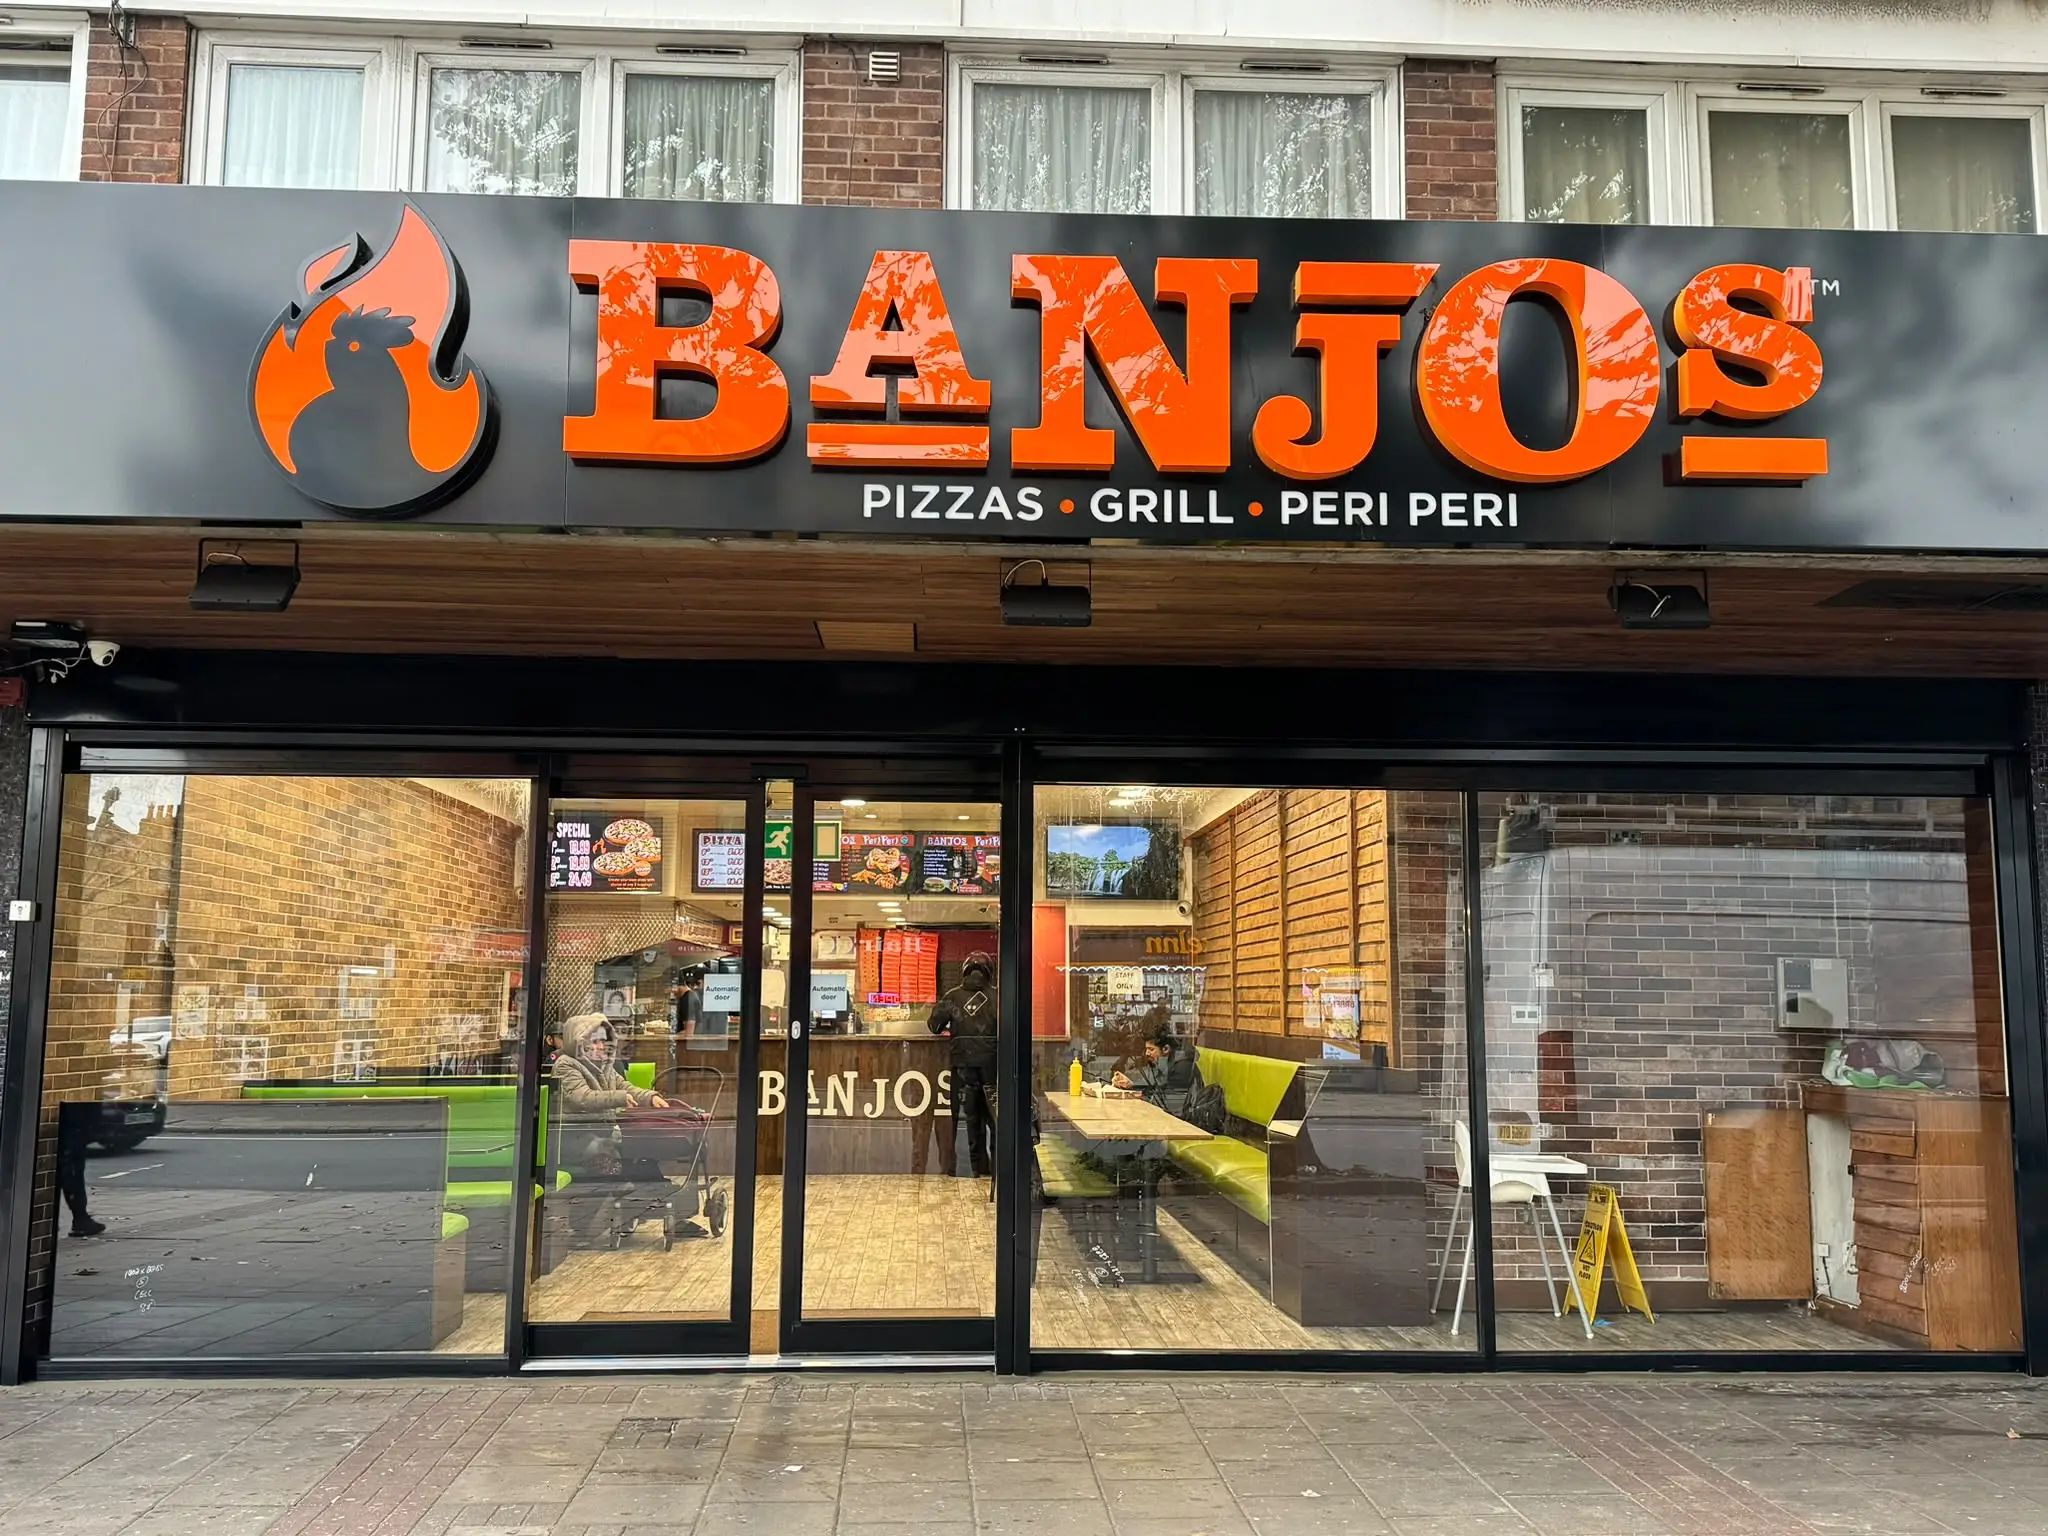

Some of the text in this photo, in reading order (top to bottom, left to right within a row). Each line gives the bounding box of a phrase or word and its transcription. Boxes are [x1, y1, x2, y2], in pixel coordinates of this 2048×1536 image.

[563, 239, 1828, 483] BANJOS
[862, 483, 1518, 528] PIZZAS GRILL PERI PERI
[556, 822, 591, 838] SPECIAL
[703, 835, 742, 846] PIZZA
[928, 836, 967, 846] BANJOS
